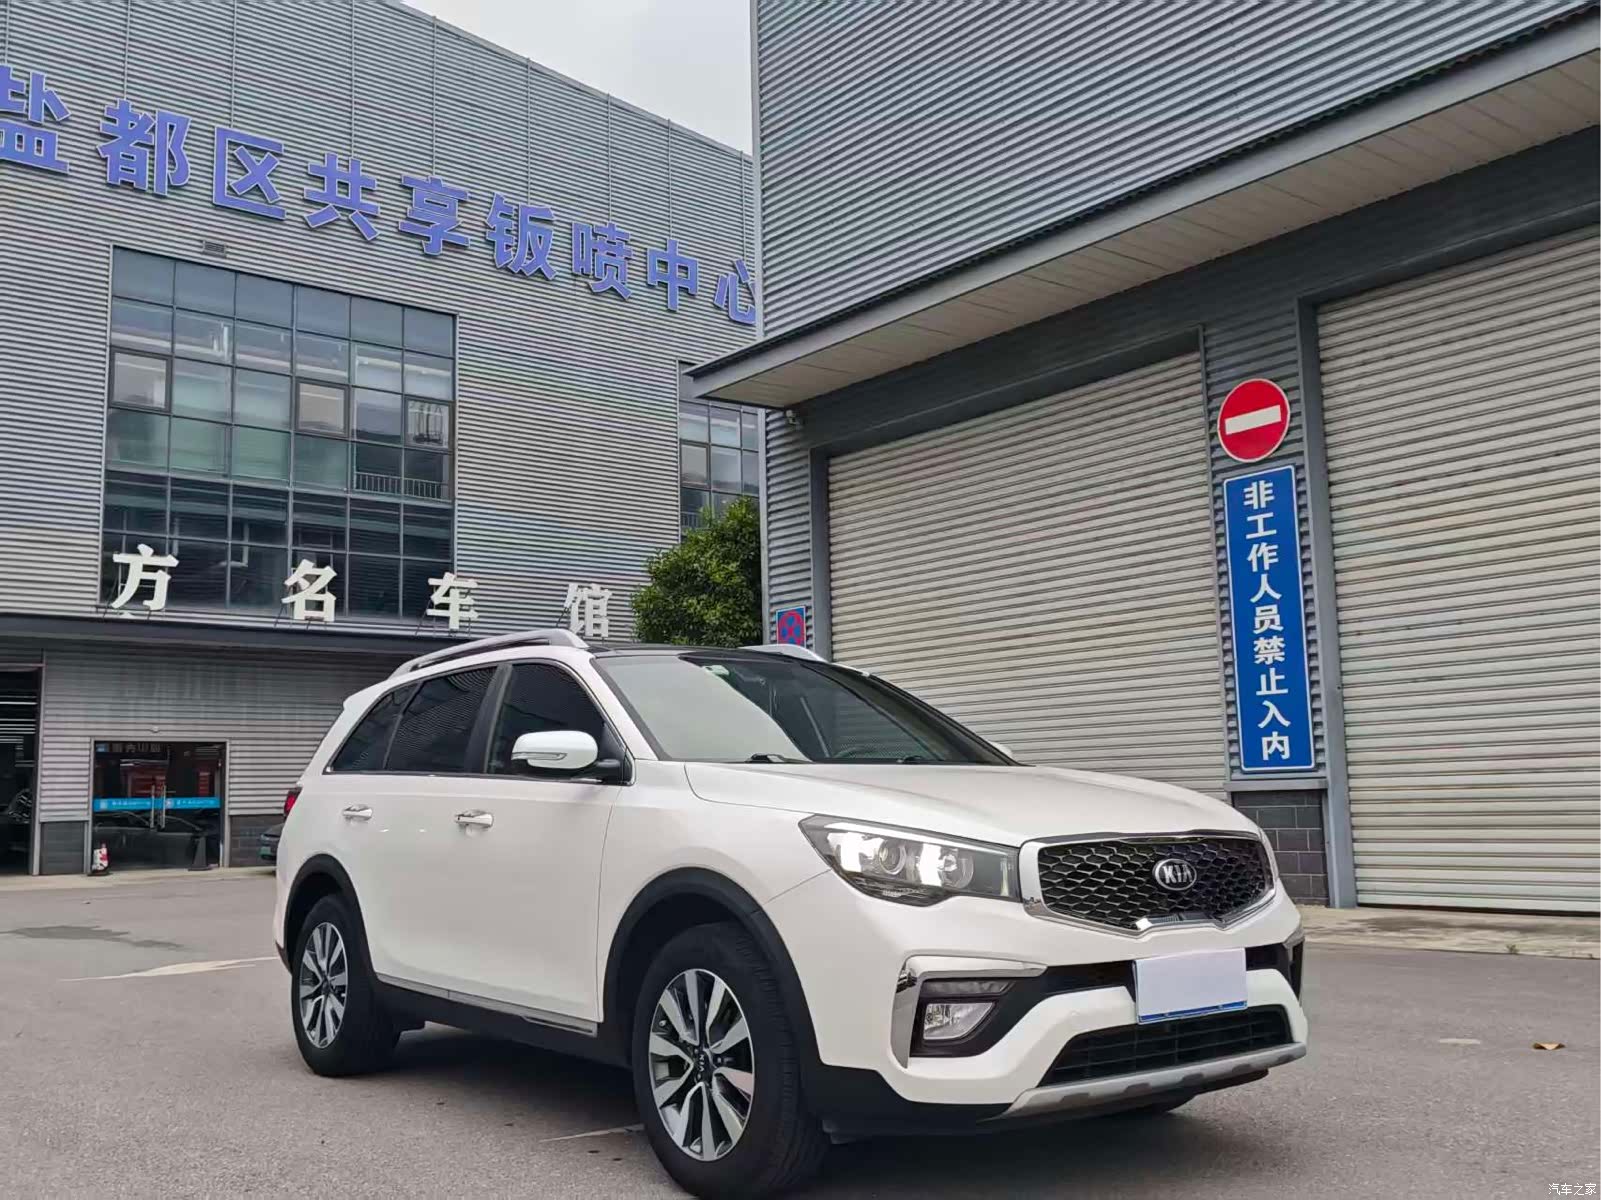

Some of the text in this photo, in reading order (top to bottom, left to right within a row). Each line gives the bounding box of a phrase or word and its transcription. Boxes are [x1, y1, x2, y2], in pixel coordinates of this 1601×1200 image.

[0, 64, 756, 325] 盐都区共享钣喷中心
[111, 543, 612, 638] 方名车馆
[1243, 480, 1291, 761] 非工作人员禁止入内
[1161, 864, 1193, 884] KIA
